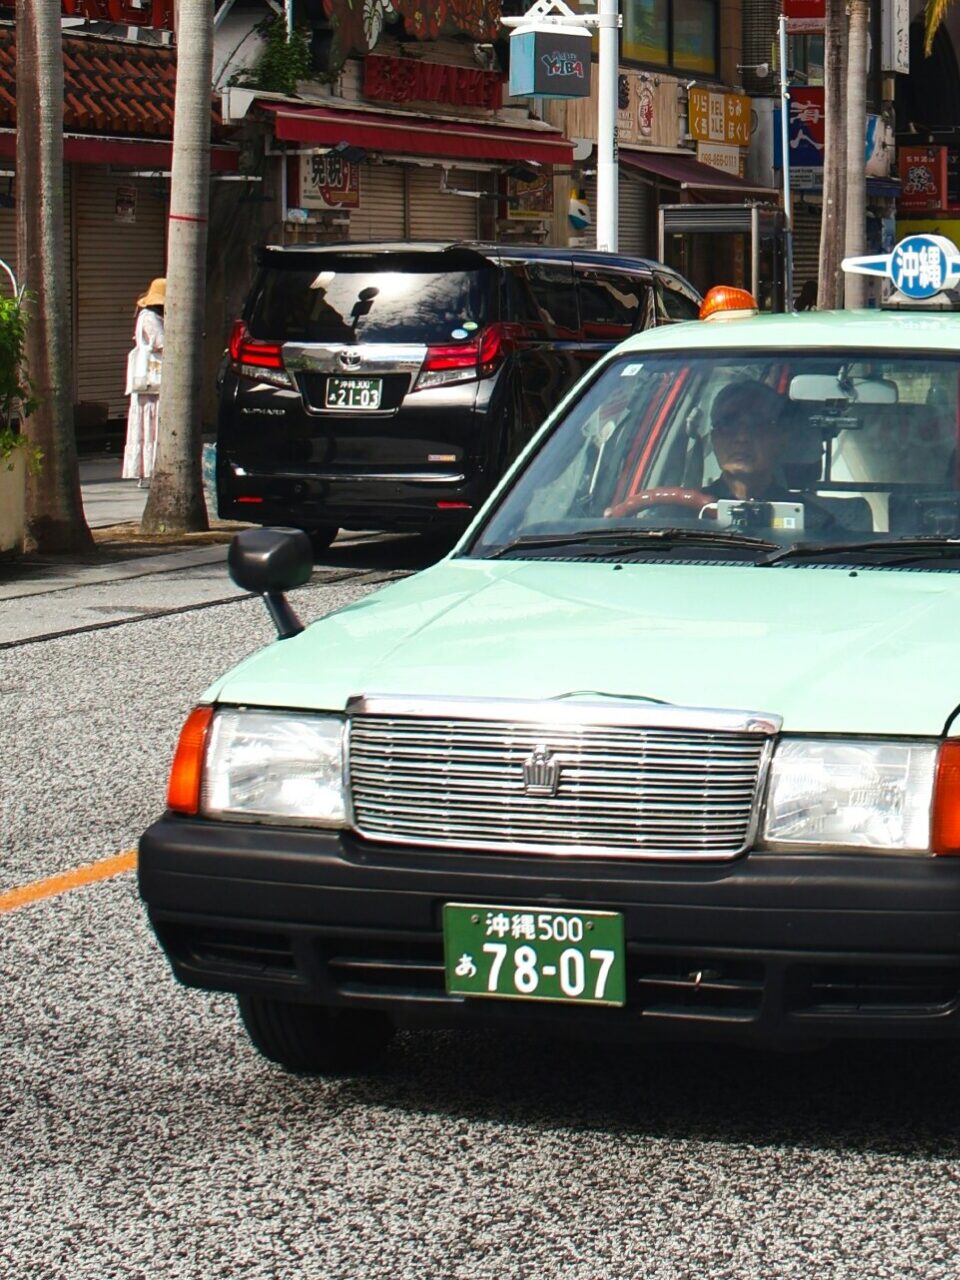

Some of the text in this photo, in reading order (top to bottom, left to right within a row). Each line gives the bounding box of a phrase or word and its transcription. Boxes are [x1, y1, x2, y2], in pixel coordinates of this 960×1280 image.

[896, 245, 941, 289] 沖縄
[338, 389, 379, 406] 21-03
[485, 912, 583, 942] 沖縄500
[455, 943, 615, 999] あ 78-07
